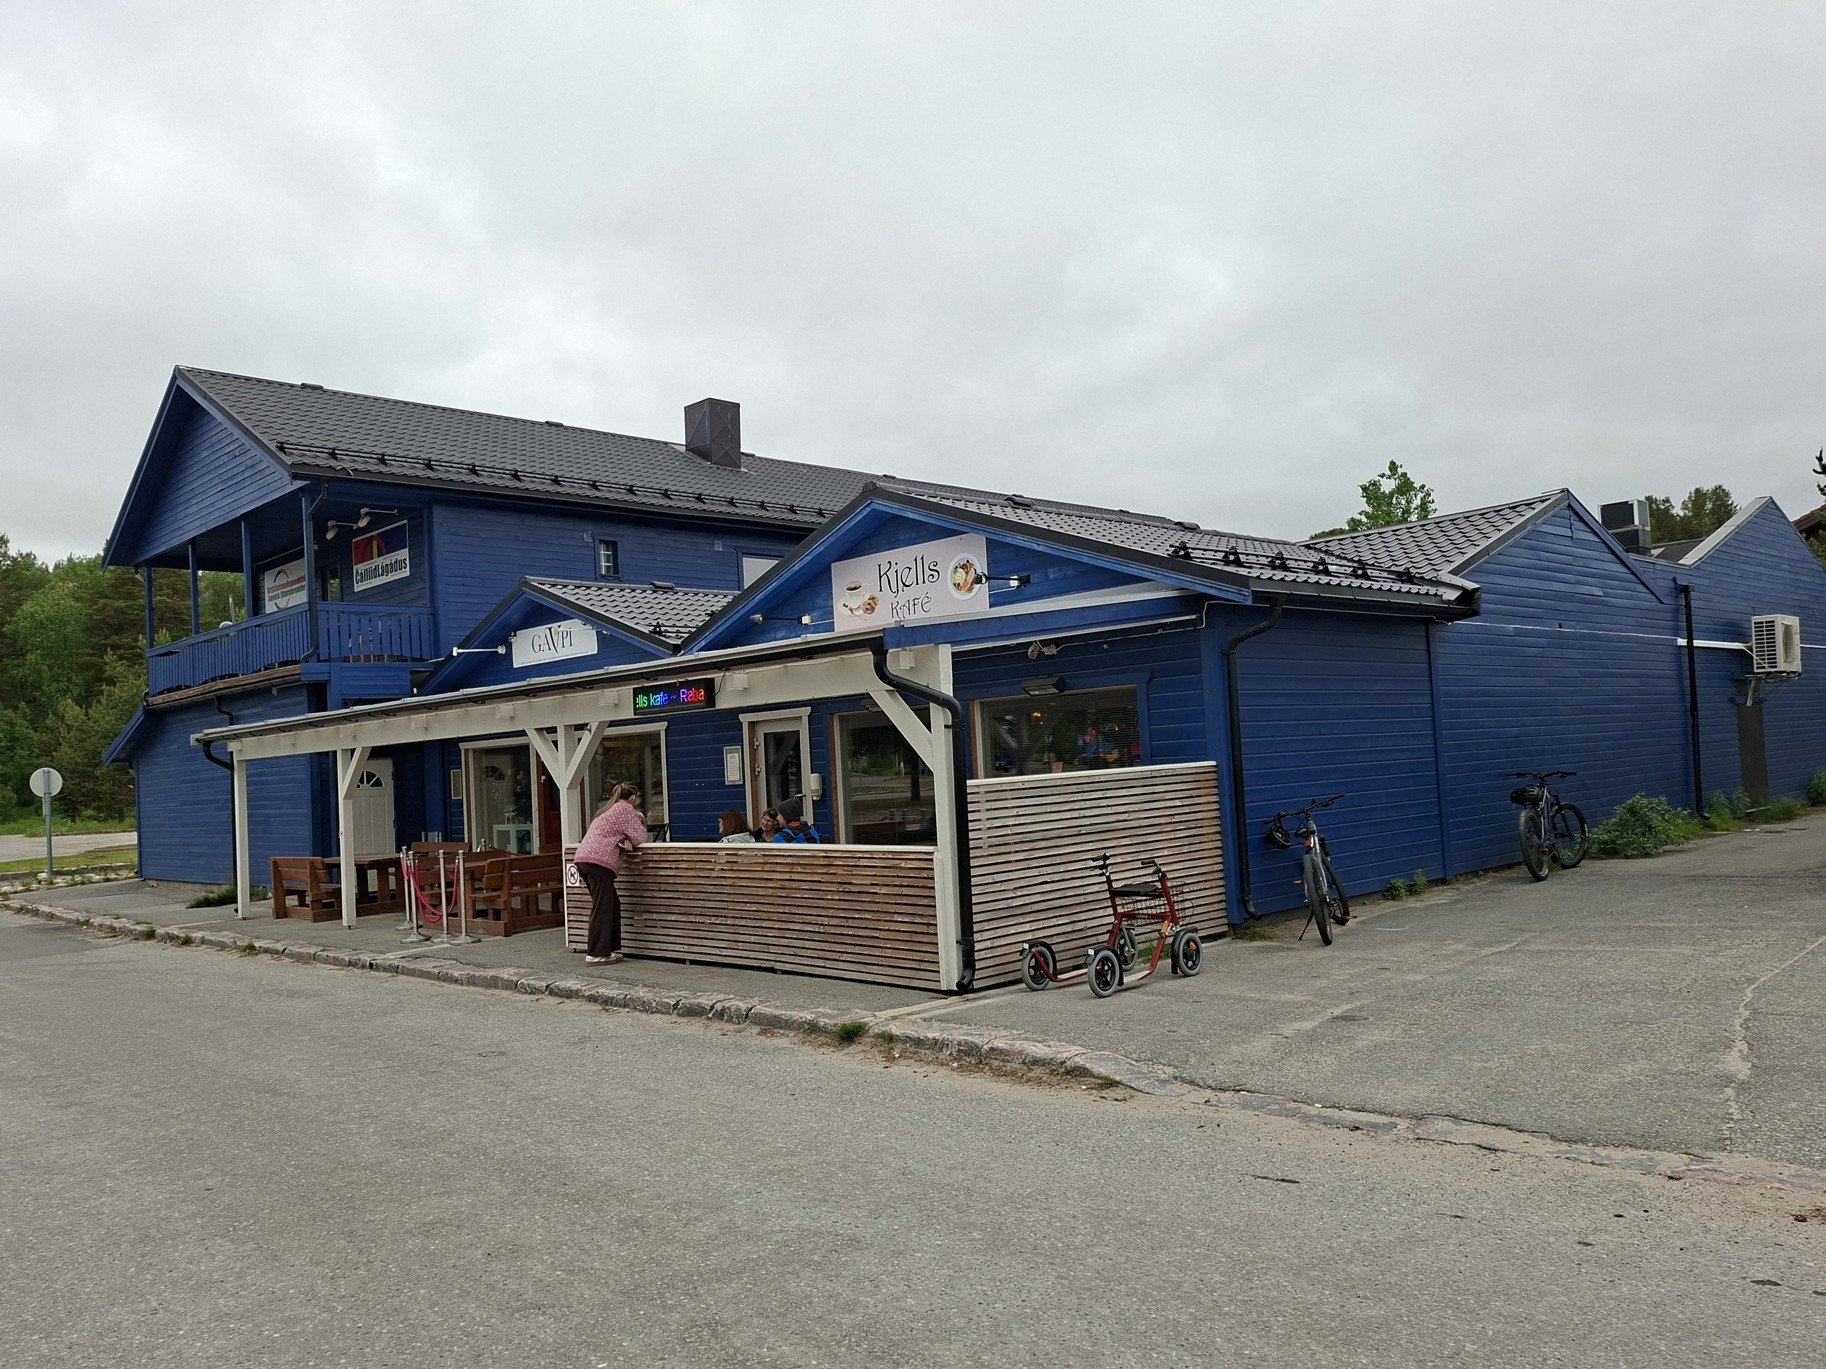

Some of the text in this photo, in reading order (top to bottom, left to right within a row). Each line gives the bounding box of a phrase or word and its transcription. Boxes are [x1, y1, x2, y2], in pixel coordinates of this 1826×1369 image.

[877, 554, 941, 598] Kjells
[891, 591, 932, 619] KAFÉ
[531, 624, 574, 654] GAVPI
[649, 691, 669, 706] kafe
[679, 688, 705, 703] Raba
